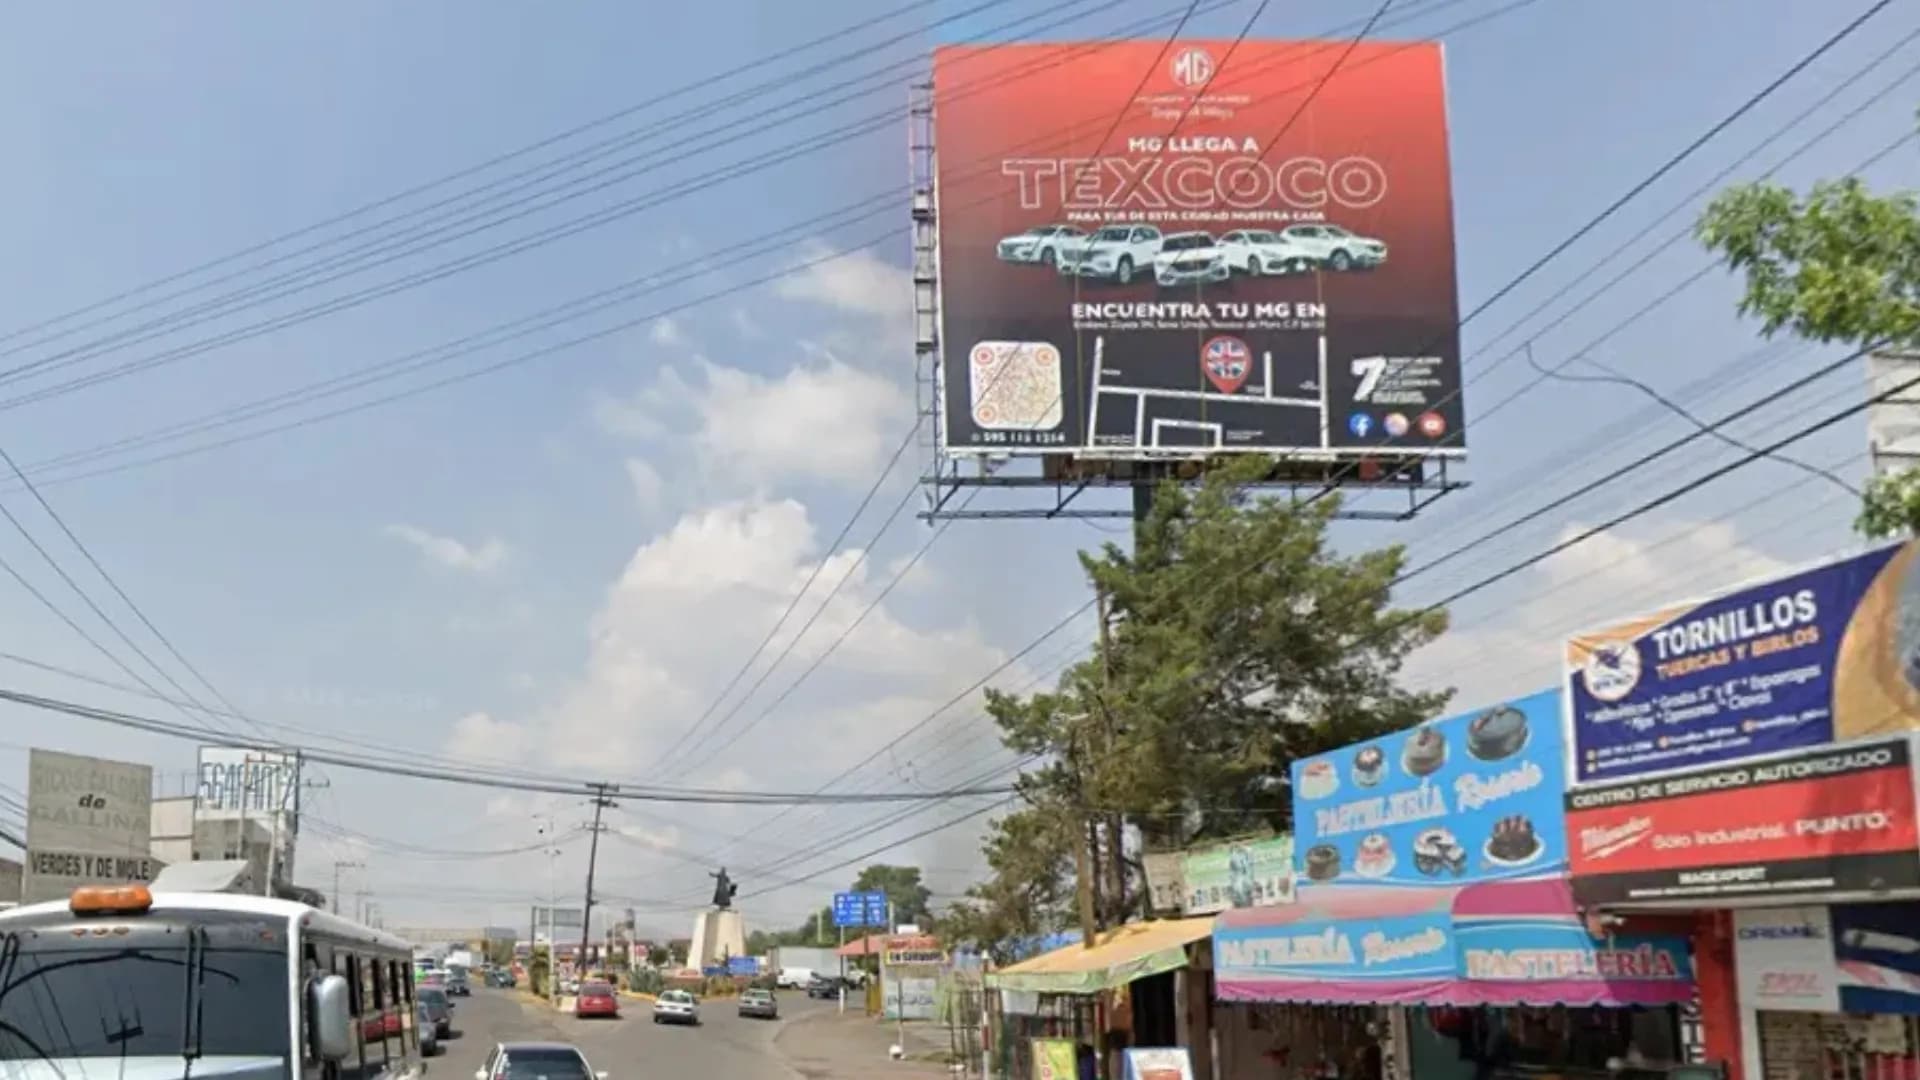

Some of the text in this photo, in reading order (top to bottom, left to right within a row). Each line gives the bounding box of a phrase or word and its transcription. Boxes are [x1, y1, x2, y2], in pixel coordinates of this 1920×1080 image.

[1174, 51, 1210, 85] MG
[1128, 136, 1260, 153] MG LLEGA A
[1002, 156, 1388, 209] TEXCOCO
[1067, 211, 1101, 222] PARA
[1129, 211, 1146, 222] DE
[1232, 211, 1290, 222] NUESTRA
[1292, 211, 1326, 222] CASA
[1072, 302, 1326, 318] ENCUENTRA TU MG EN
[1351, 356, 1386, 402] 7
[1652, 590, 1818, 660] TORNILLOS
[1655, 646, 1731, 681] TUERCAS
[1734, 643, 1747, 660] Y
[1573, 788, 1636, 808] CENTRO
[1638, 782, 1662, 799] DE
[1664, 769, 1749, 795] SERVICIO
[1754, 748, 1892, 782] AUTORIZADO
[30, 804, 149, 831] GALLINA
[78, 793, 107, 810] de
[1315, 776, 1448, 837] PASTELERÍA
[31, 851, 150, 881] VERDES Y DE MOLE
[1219, 926, 1356, 968] PASTELERÍA
[1466, 943, 1680, 979] PASTELERÍA
